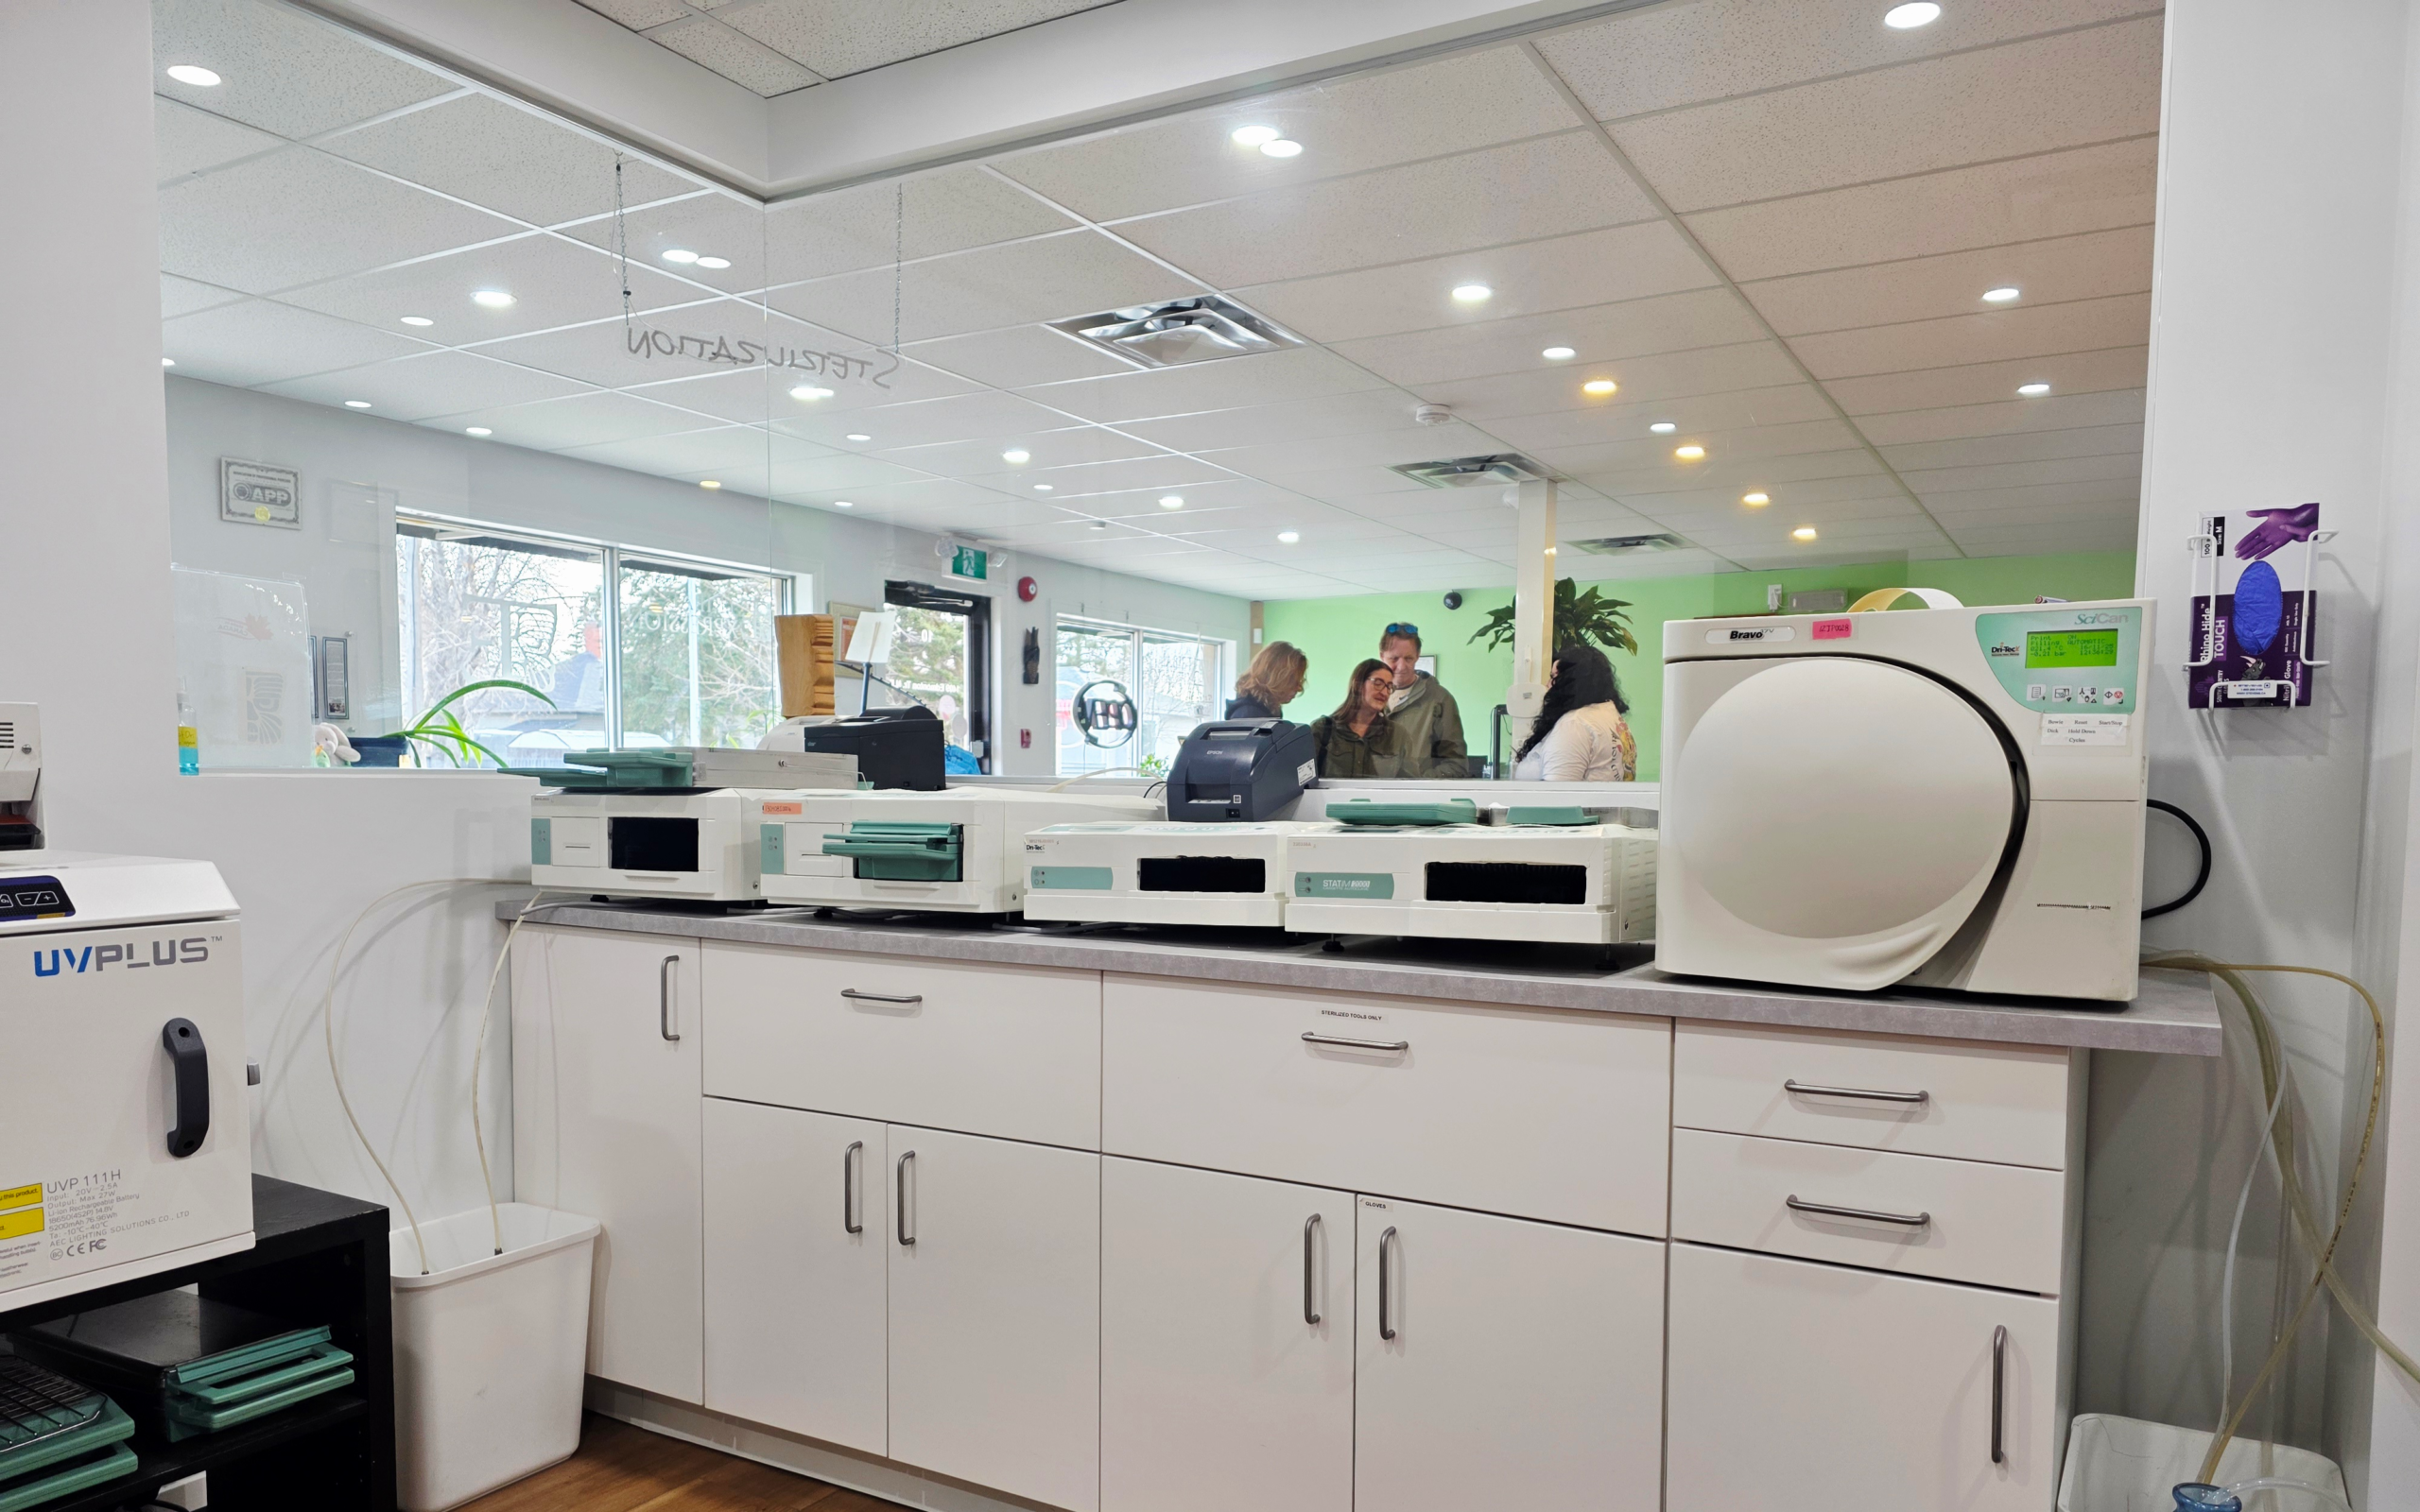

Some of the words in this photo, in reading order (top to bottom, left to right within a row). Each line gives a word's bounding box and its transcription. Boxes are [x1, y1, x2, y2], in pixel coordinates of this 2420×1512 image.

[251, 487, 289, 505] APP
[2074, 612, 2129, 625] SciCan
[2201, 608, 2211, 631] Hide
[1729, 629, 1763, 640] Bravo
[2213, 619, 2225, 659] TOUCH
[2284, 660, 2292, 679] Glove
[1322, 879, 1351, 887] STATIM
[33, 937, 209, 977] UVPLUS
[1321, 1009, 1350, 1018] STERILIZED
[47, 1177, 78, 1194] UVP
[83, 1169, 121, 1186] 111H
[3, 1192, 14, 1200] this
[47, 1192, 69, 1202] Input:
[47, 1199, 77, 1210] Output:
[79, 1194, 95, 1203] Max
[98, 1190, 116, 1199] 27W
[48, 1207, 68, 1217] Li-ion
[69, 1198, 114, 1212] Rechargeable
[115, 1193, 140, 1203] Battery
[50, 1238, 66, 1247] AEC
[69, 1229, 107, 1244] LIGHTING
[110, 1218, 156, 1234] SOLUTIONS
[176, 1210, 190, 1219] LTD
